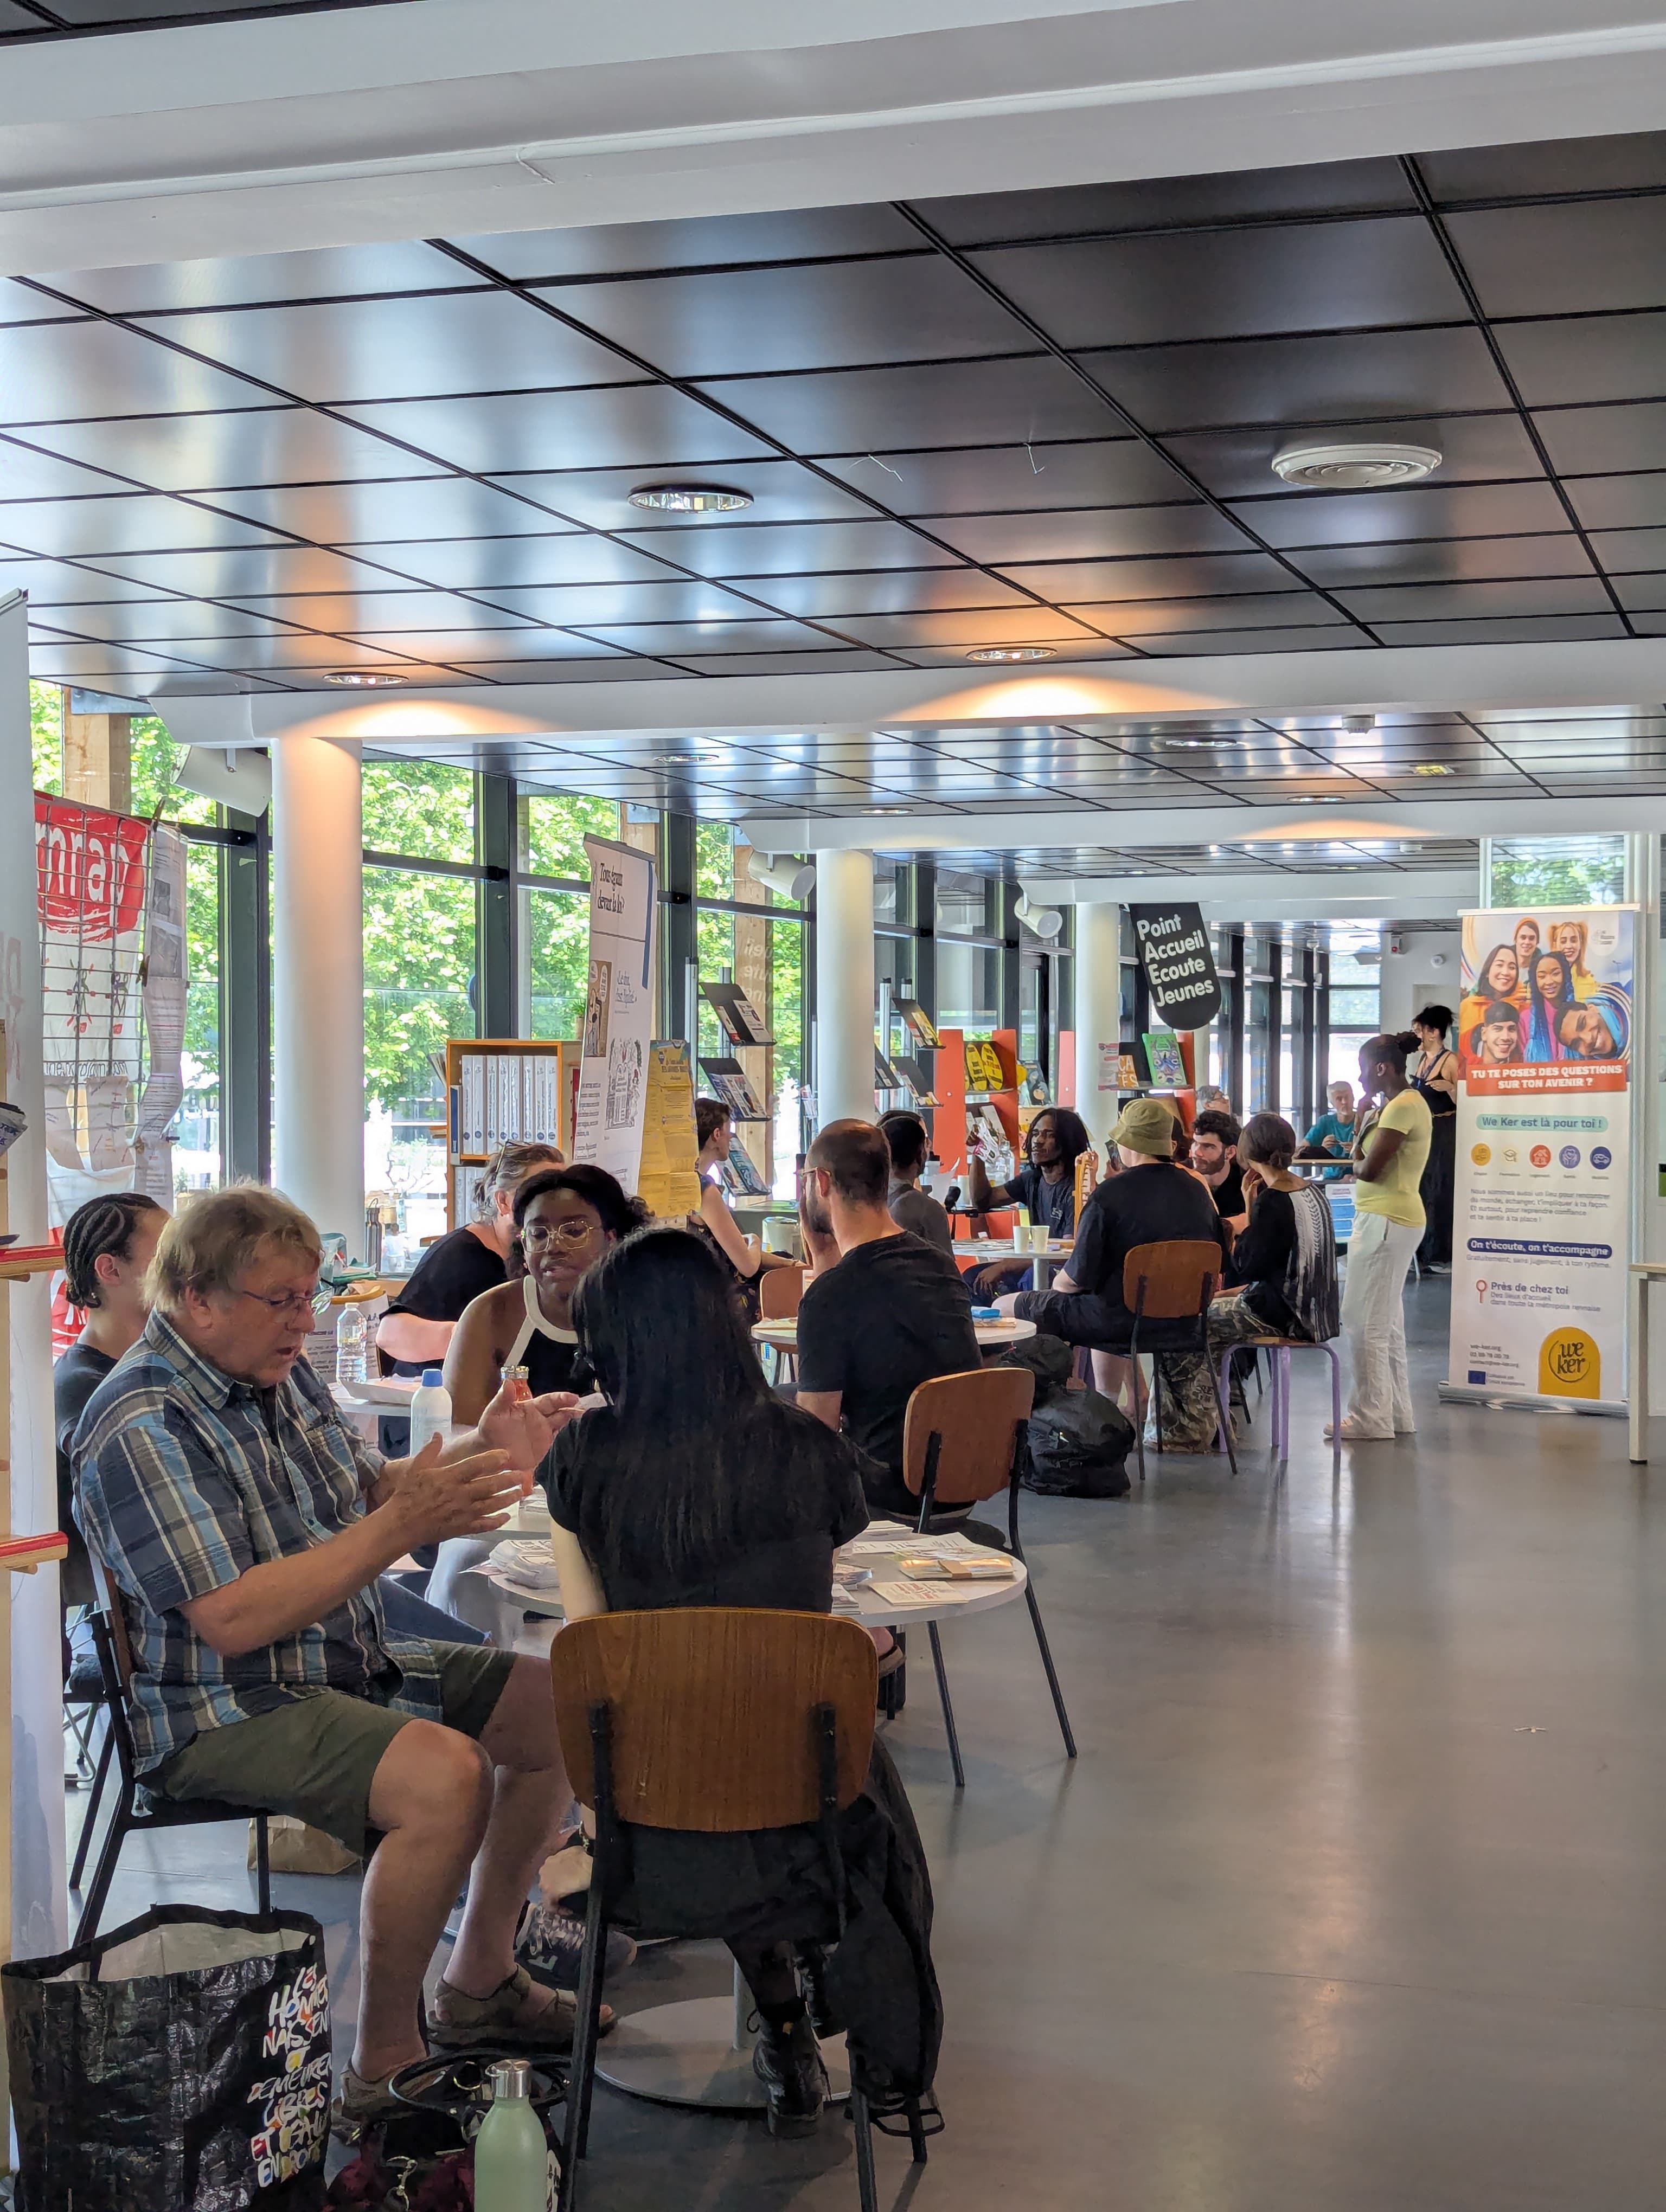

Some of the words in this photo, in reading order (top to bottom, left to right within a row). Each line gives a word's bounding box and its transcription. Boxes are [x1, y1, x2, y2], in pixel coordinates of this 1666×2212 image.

[1137, 914, 1181, 941] Point
[1145, 930, 1204, 963] Accueil
[1148, 957, 1206, 985] Ecoute
[1156, 980, 1214, 1007] Jeunes
[1471, 1070, 1485, 1079] TU
[1488, 1069, 1501, 1078] TE
[1502, 1068, 1536, 1078] POSES
[1538, 1067, 1559, 1076] DES
[1561, 1065, 1622, 1077] QUESTIONS
[1498, 1079, 1519, 1089] SUR
[1521, 1079, 1543, 1088] TON
[1545, 1078, 1584, 1088] AVENIR
[1586, 1078, 1593, 1086] ?
[1482, 1117, 1497, 1126] We
[1501, 1117, 1518, 1126] Ker
[1521, 1118, 1537, 1127] est
[1541, 1117, 1550, 1127] là
[1553, 1119, 1578, 1129] pour
[1581, 1119, 1595, 1128] toi
[1470, 1240, 1484, 1249] On
[1485, 1240, 1526, 1252] t'écoute,
[1543, 1243, 1609, 1257] t'accompagne
[1491, 1282, 1512, 1290] Près
[1515, 1283, 1527, 1292] de
[1529, 1284, 1553, 1294] chez
[1555, 1285, 1568, 1295] toi
[1560, 1342, 1584, 1356] we
[1557, 1354, 1585, 1374] ker
